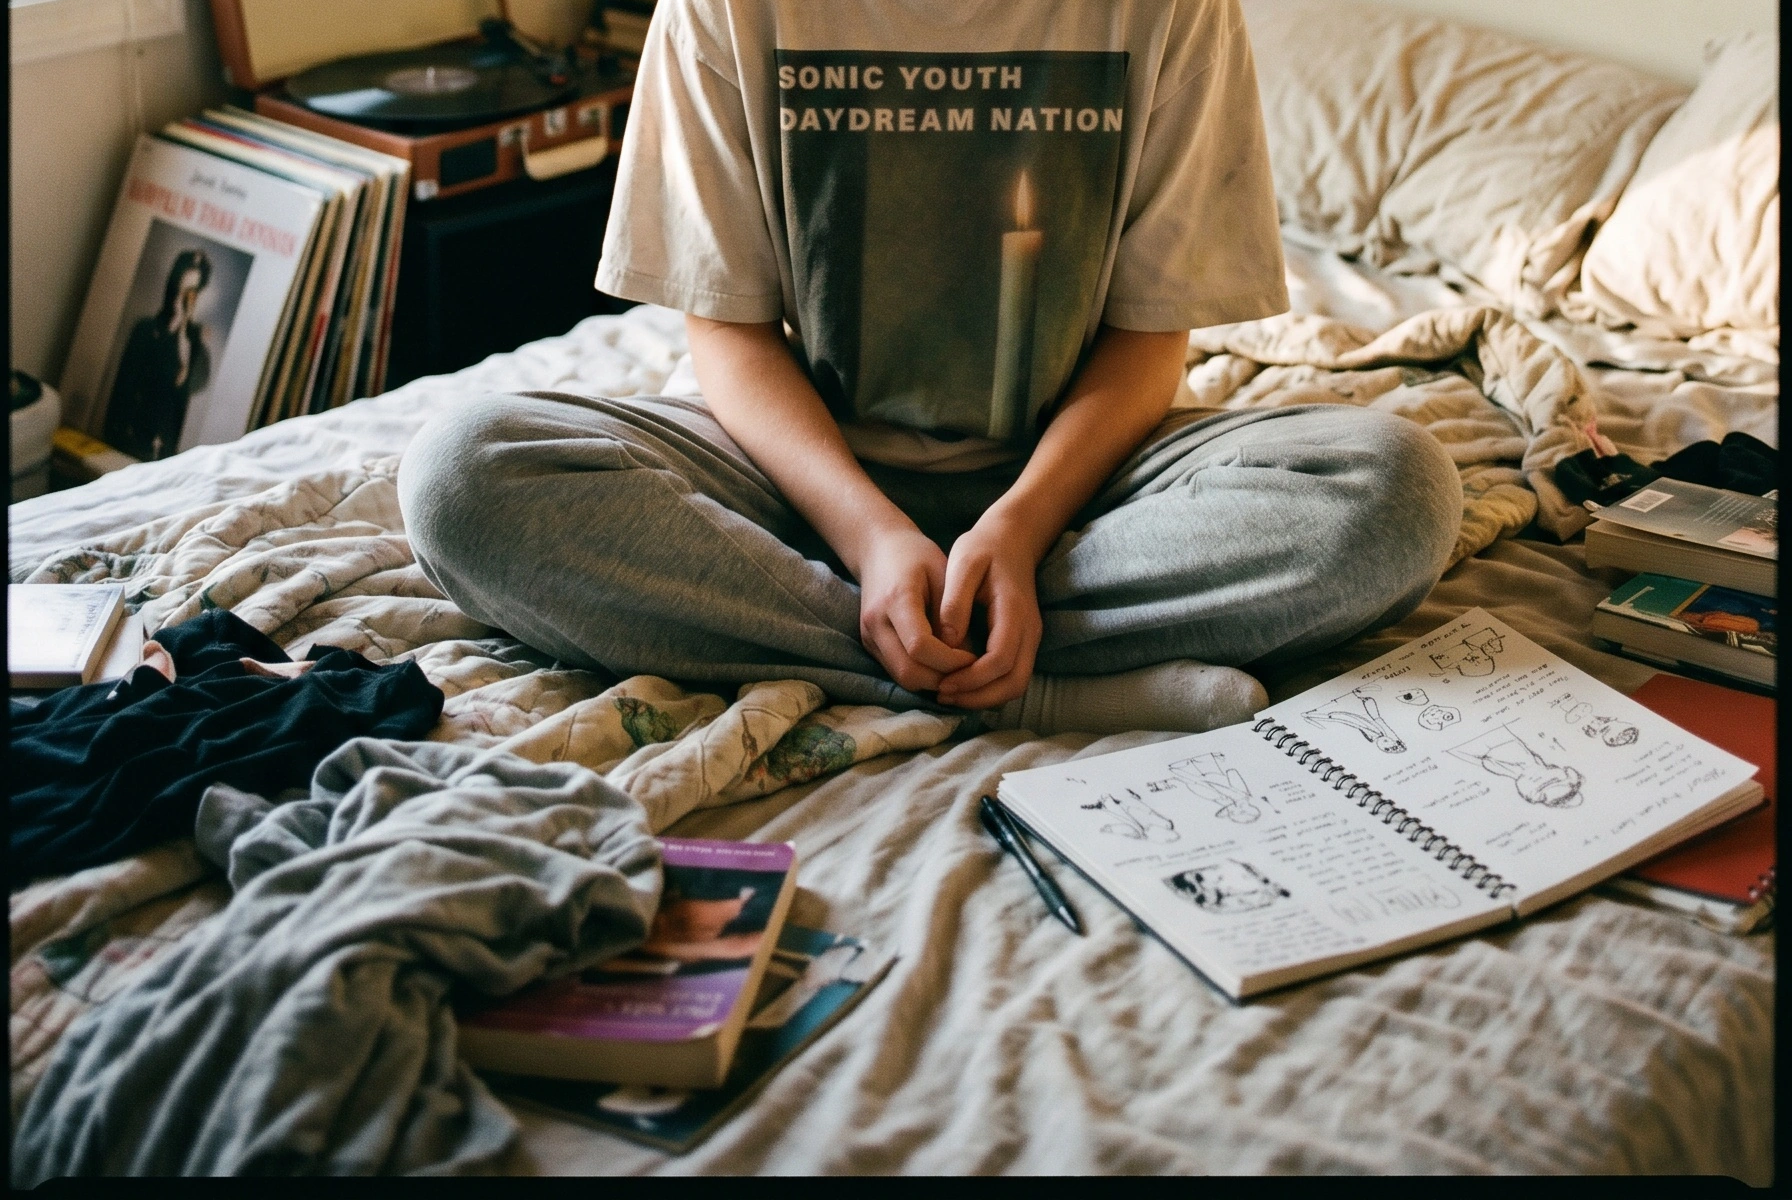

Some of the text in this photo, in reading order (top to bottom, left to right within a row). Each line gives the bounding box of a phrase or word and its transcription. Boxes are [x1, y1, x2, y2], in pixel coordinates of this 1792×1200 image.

[778, 66, 1022, 90] SONIC YOUTH
[779, 107, 1123, 132] DAYDREAM NATION
